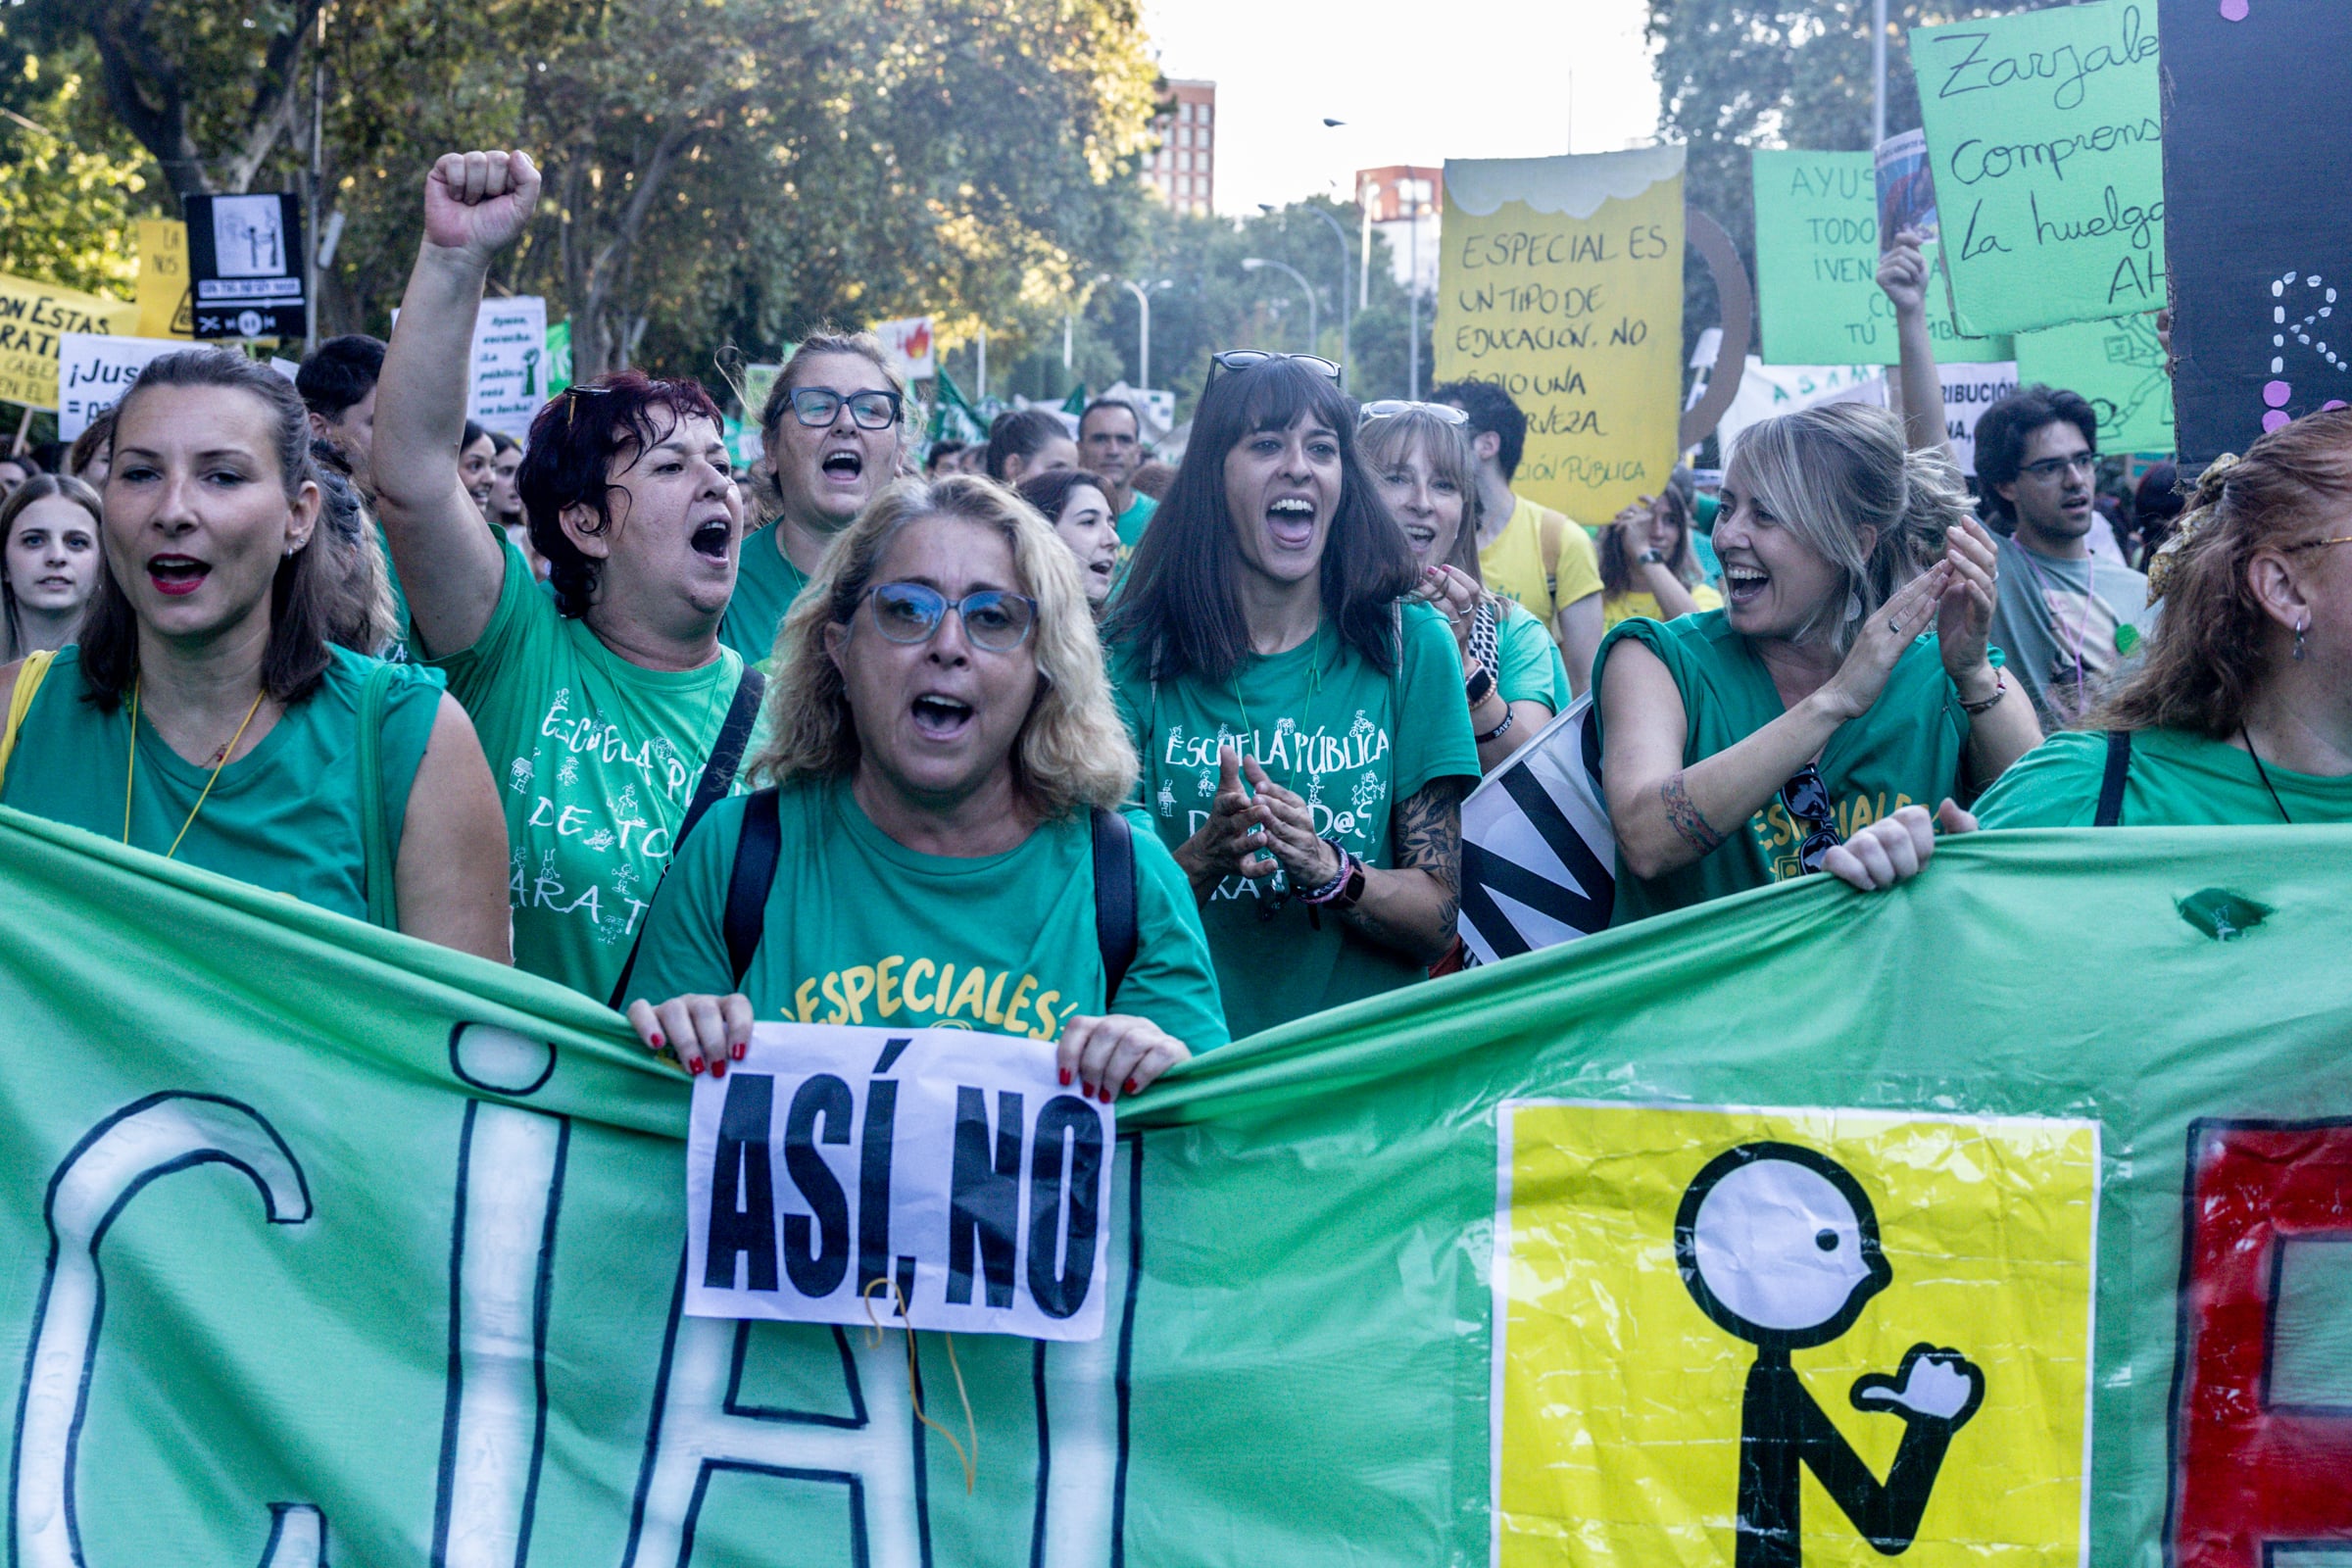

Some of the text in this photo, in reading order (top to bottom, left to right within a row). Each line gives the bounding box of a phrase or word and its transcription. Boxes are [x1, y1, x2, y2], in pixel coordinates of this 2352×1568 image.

[1462, 225, 1668, 269] ESPECIAL ES
[1962, 198, 2012, 261] La
[30, 296, 110, 335] ESTAS
[1459, 282, 1606, 318] UN TIPO DE
[1609, 317, 1647, 348] NO
[1844, 316, 1876, 345] TÚ
[1534, 365, 1586, 395] UNA
[1561, 455, 1646, 489] PÚBLICA
[1295, 725, 1390, 775] PÚBLICA
[529, 797, 592, 836] DE
[795, 955, 1060, 1043] ESPECIALES
[703, 1038, 1104, 1320] ASÍ, NO
